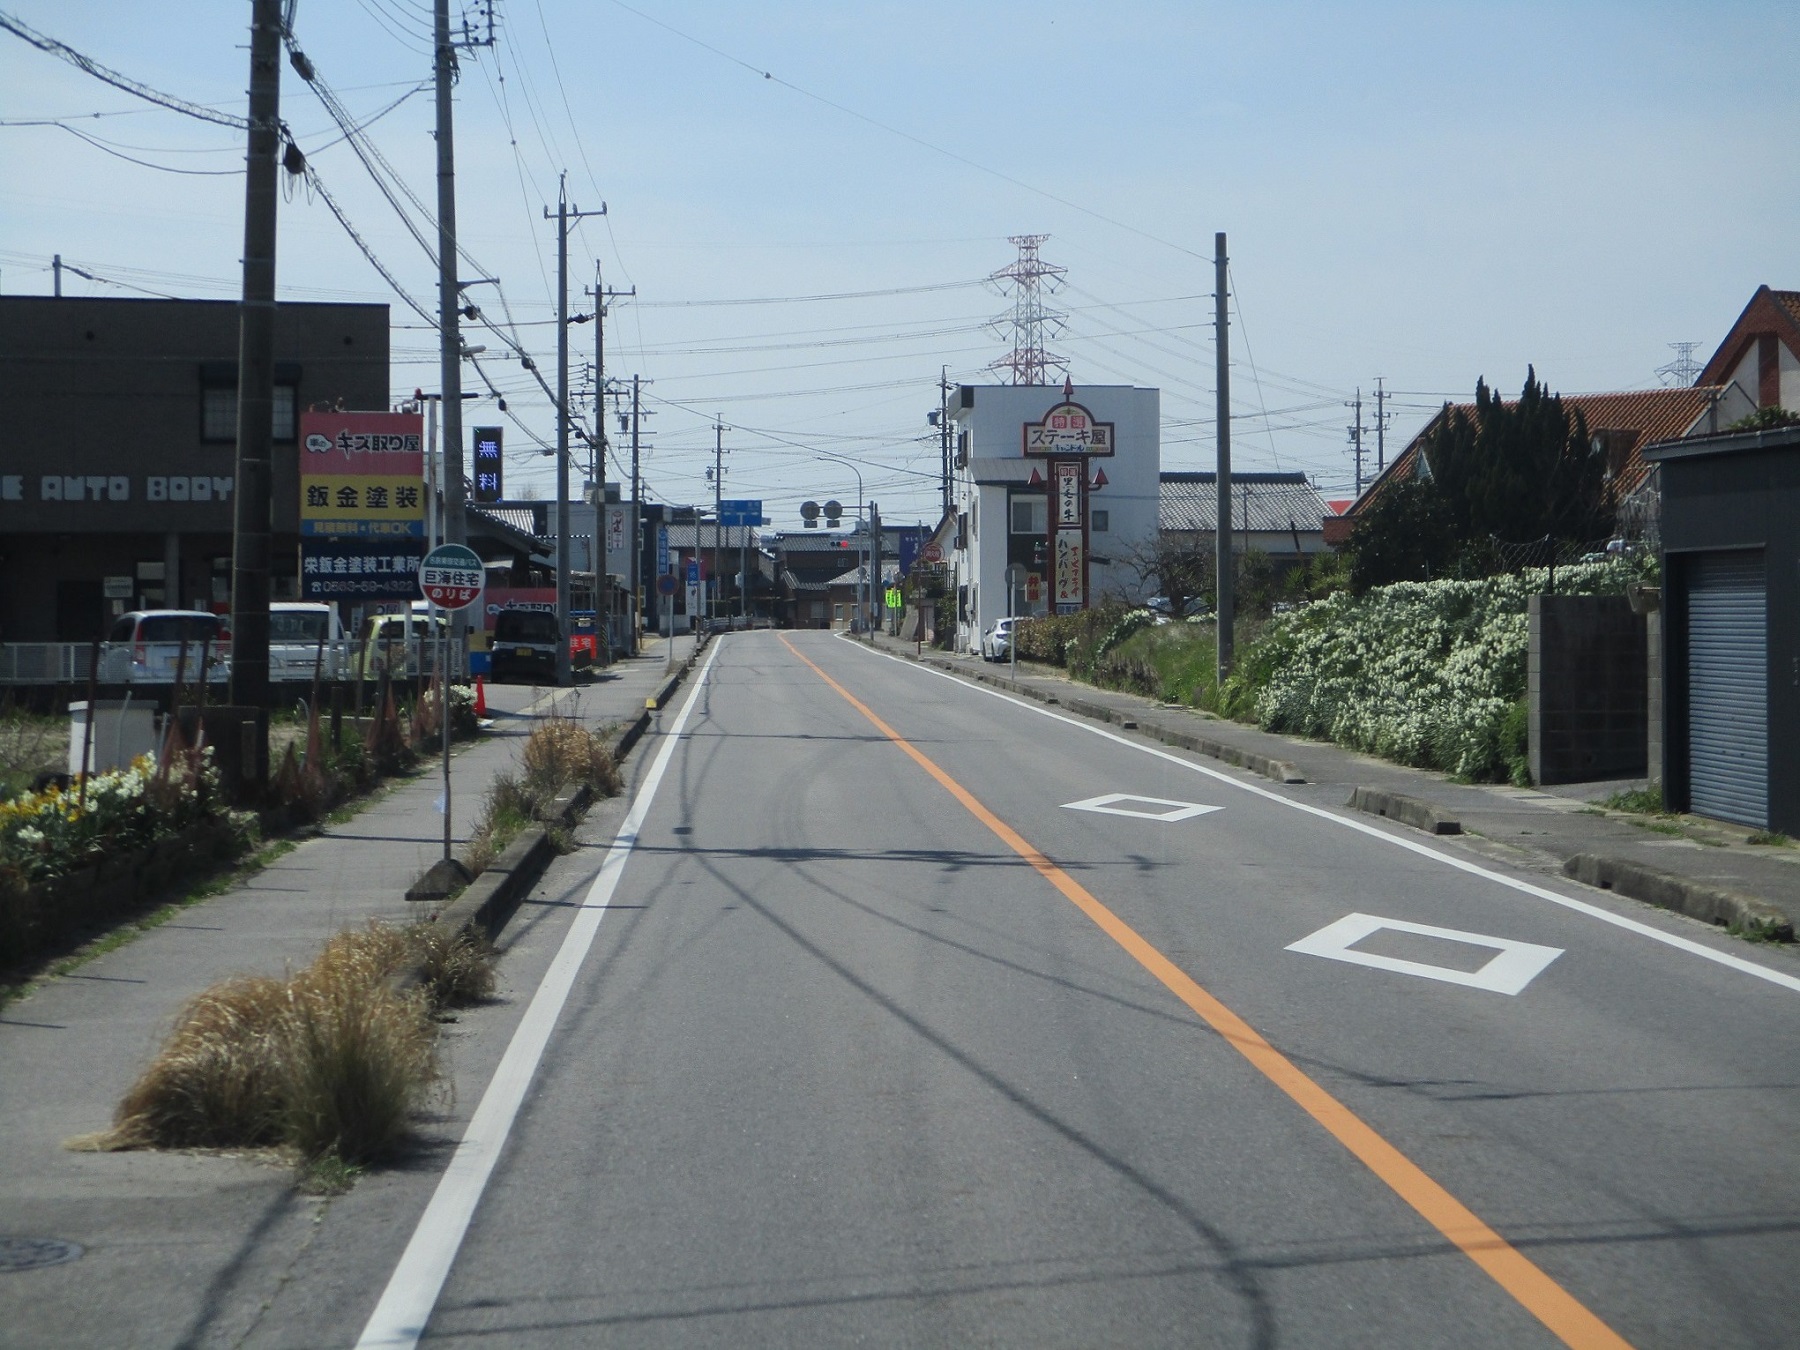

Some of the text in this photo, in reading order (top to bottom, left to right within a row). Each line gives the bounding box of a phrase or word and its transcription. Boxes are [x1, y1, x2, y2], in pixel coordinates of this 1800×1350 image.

[336, 429, 420, 457] キズ取り屋
[1032, 429, 1106, 445] ステーキ屋
[479, 441, 497, 491] 無料
[2, 475, 233, 500] E AUTO BODY
[307, 485, 418, 508] 鈑金塗装
[1063, 477, 1074, 521] 黒毛の牛
[304, 555, 420, 573] 栄鈑金塗装工業所
[425, 570, 480, 586] 巨海住宅
[1028, 576, 1039, 601] 弁当
[431, 588, 471, 600] のりば
